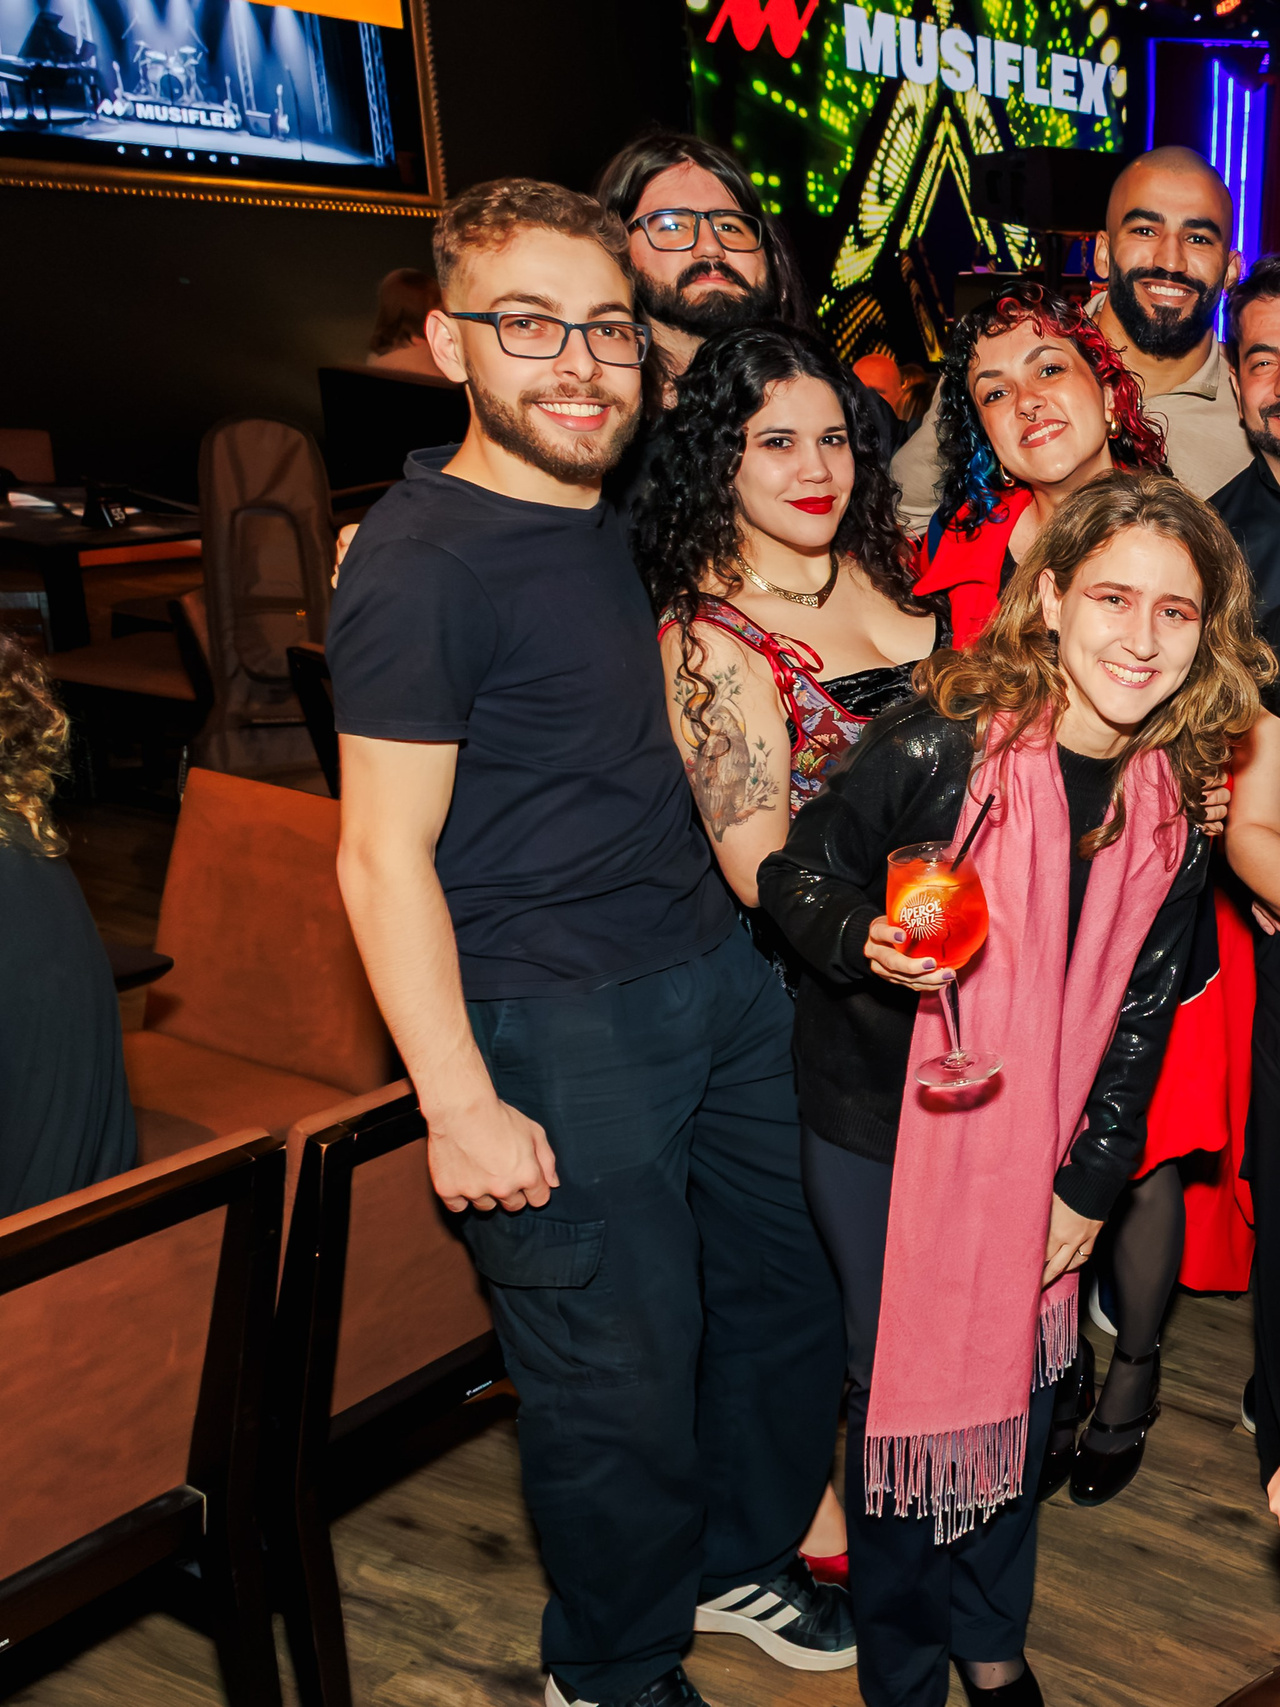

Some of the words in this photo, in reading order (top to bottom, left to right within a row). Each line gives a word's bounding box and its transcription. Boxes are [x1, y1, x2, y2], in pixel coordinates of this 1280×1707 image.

[136, 102, 237, 128] MUSIFLEX
[900, 901, 942, 922] APEROL
[906, 913, 936, 929] SPRITZ
